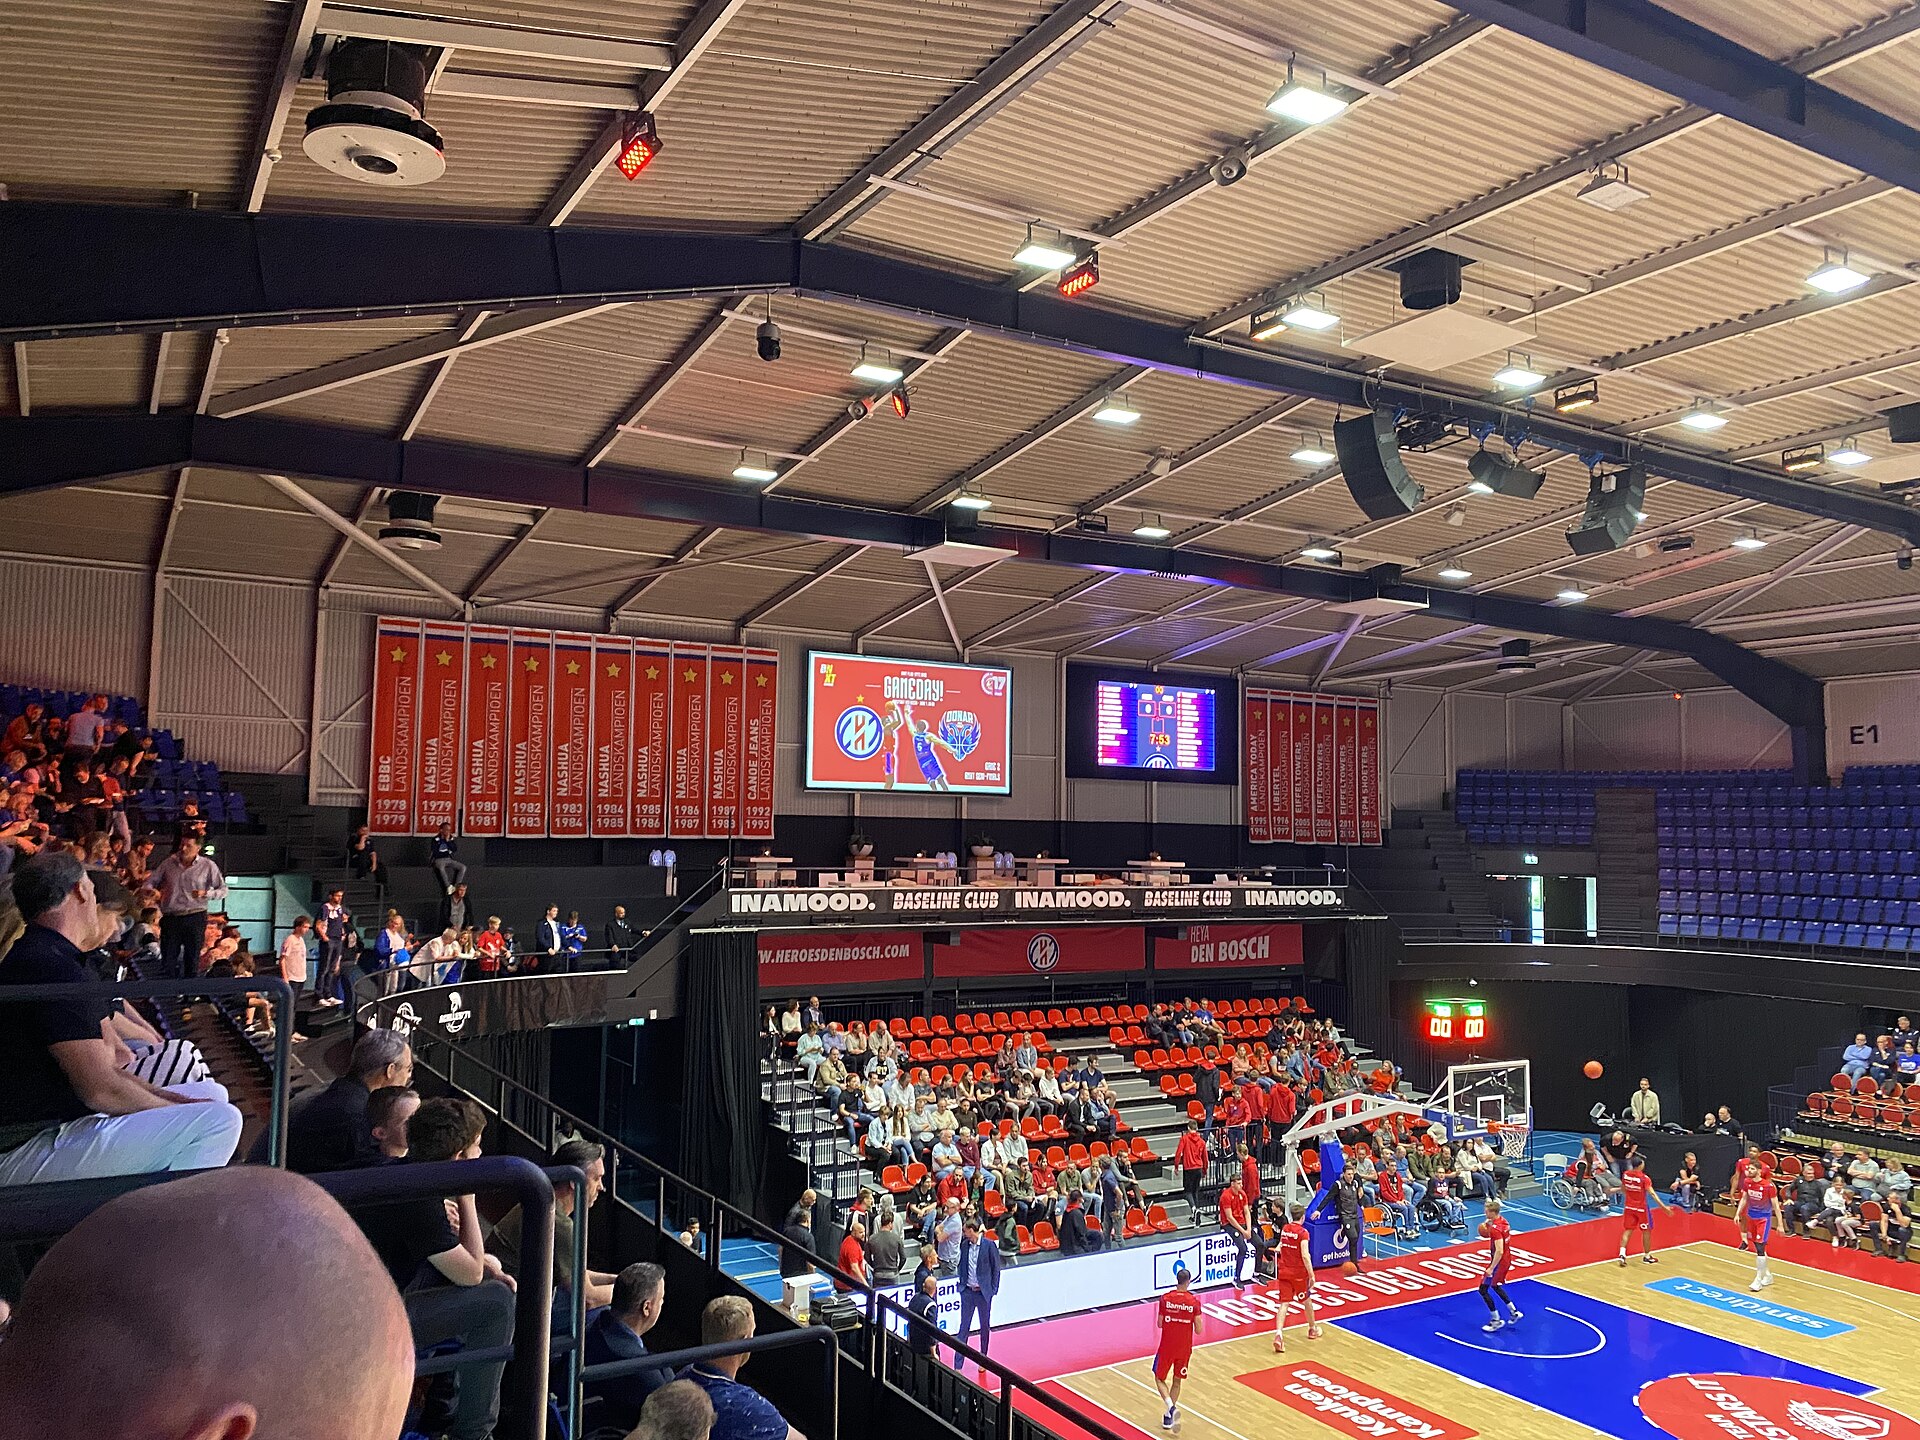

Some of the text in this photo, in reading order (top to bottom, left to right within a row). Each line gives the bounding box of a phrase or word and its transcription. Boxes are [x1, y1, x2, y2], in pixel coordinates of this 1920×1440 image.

[884, 676, 944, 702] GAMEDAY!
[992, 676, 1006, 690] 17
[946, 711, 974, 722] DONAR
[392, 676, 412, 792] LANDSKAMPIOEN
[440, 679, 457, 794] LANDSKAMPIOEN
[486, 682, 502, 794] LANDSKAMPIOEN
[528, 685, 544, 796] LANDSKAMPIOEN
[571, 688, 586, 796] LANDSKAMPIOEN
[612, 690, 626, 797] LANDSKAMPIOEN
[651, 692, 664, 798] LANDSKAMPIOEN
[1150, 734, 1170, 746] 7:53
[1850, 724, 1878, 744] E1
[689, 695, 701, 798] LANDSKAMPIOEN
[726, 696, 738, 800] LANDSKAMPIOEN
[760, 699, 772, 800] LANDSKAMPIOEN
[424, 738, 438, 793] NASHUA
[471, 739, 484, 794] NASHUA
[514, 742, 527, 795] NASHUA
[557, 744, 569, 796] NASHUA
[748, 718, 760, 800] CANOE JEANS
[378, 755, 392, 792] EBBC
[598, 745, 610, 797] NASHUA
[637, 746, 648, 798] NASHUA
[676, 748, 688, 798] NASHUA
[713, 749, 724, 799] NASHUA
[376, 800, 406, 810] 1978
[422, 800, 451, 812] 1979
[470, 801, 498, 812] 1980
[513, 802, 540, 813] 1982
[556, 804, 582, 814] 1983
[597, 804, 624, 814] 1984
[636, 804, 660, 814] 1985
[674, 806, 700, 815] 1986
[712, 806, 736, 815] 1987
[747, 807, 770, 816] 1992
[375, 814, 406, 824] 1979
[469, 816, 497, 826] 1981
[512, 816, 540, 827] 1983
[555, 818, 582, 828] 1984
[597, 818, 624, 828] 1985
[635, 818, 660, 828] 1986
[674, 819, 699, 828] 1987
[746, 820, 770, 829] 1993
[731, 889, 1342, 912] INAMOOD. BASELINE CLUB INAMOOD. BASELINE CLUB INAMOOD.
[1190, 926, 1210, 942] HEYA
[1191, 936, 1269, 964] DEN BOSCH
[1206, 1236, 1238, 1250] Brab
[1206, 1250, 1256, 1266] Businss
[1322, 1252, 1333, 1262] get
[904, 1281, 960, 1302] Bant
[1344, 1266, 1446, 1295] DEN
[1166, 1301, 1194, 1312] Banning
[1673, 1282, 1830, 1330] sanidirect
[1284, 1382, 1398, 1437] Keuken
[1292, 1369, 1446, 1439] Kampioen
[1686, 1378, 1797, 1440] STARS IT
[1704, 1414, 1756, 1440] TEAM
